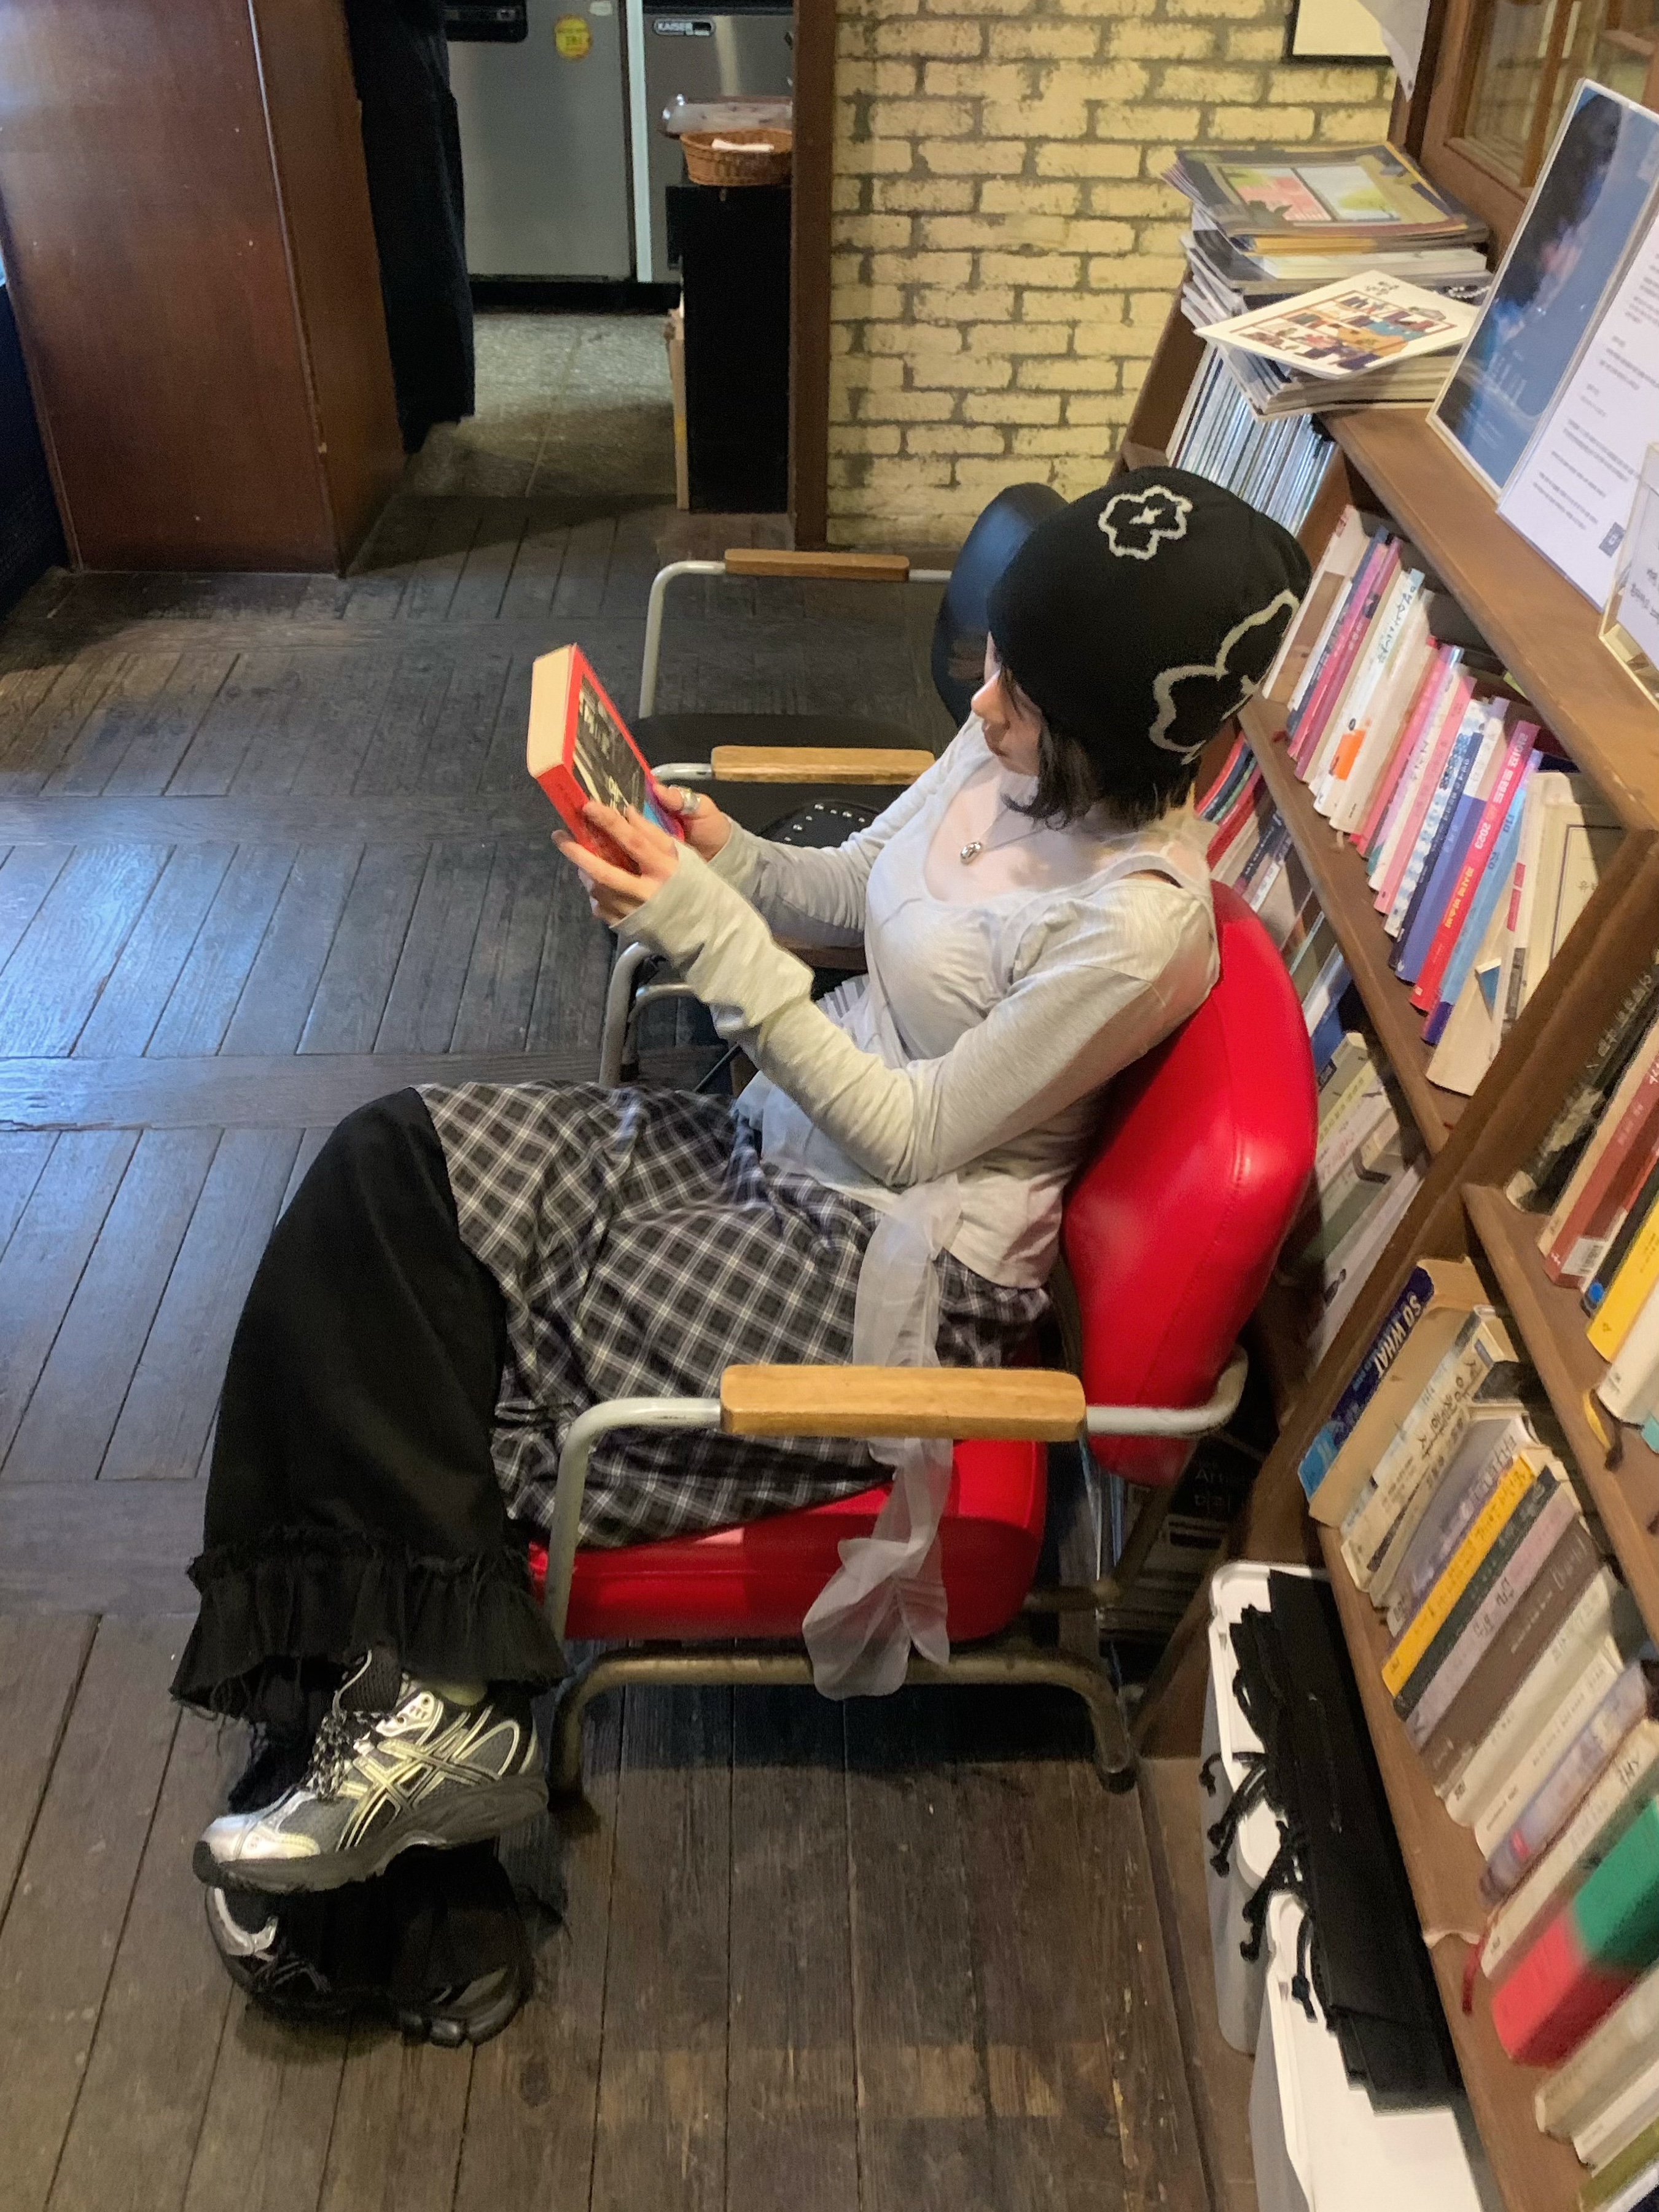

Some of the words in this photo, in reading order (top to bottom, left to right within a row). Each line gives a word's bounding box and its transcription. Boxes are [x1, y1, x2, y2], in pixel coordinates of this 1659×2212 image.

[1475, 822, 1492, 850] 2023
[1403, 1294, 1422, 1327] SO
[1374, 1322, 1406, 1379] WHAT
